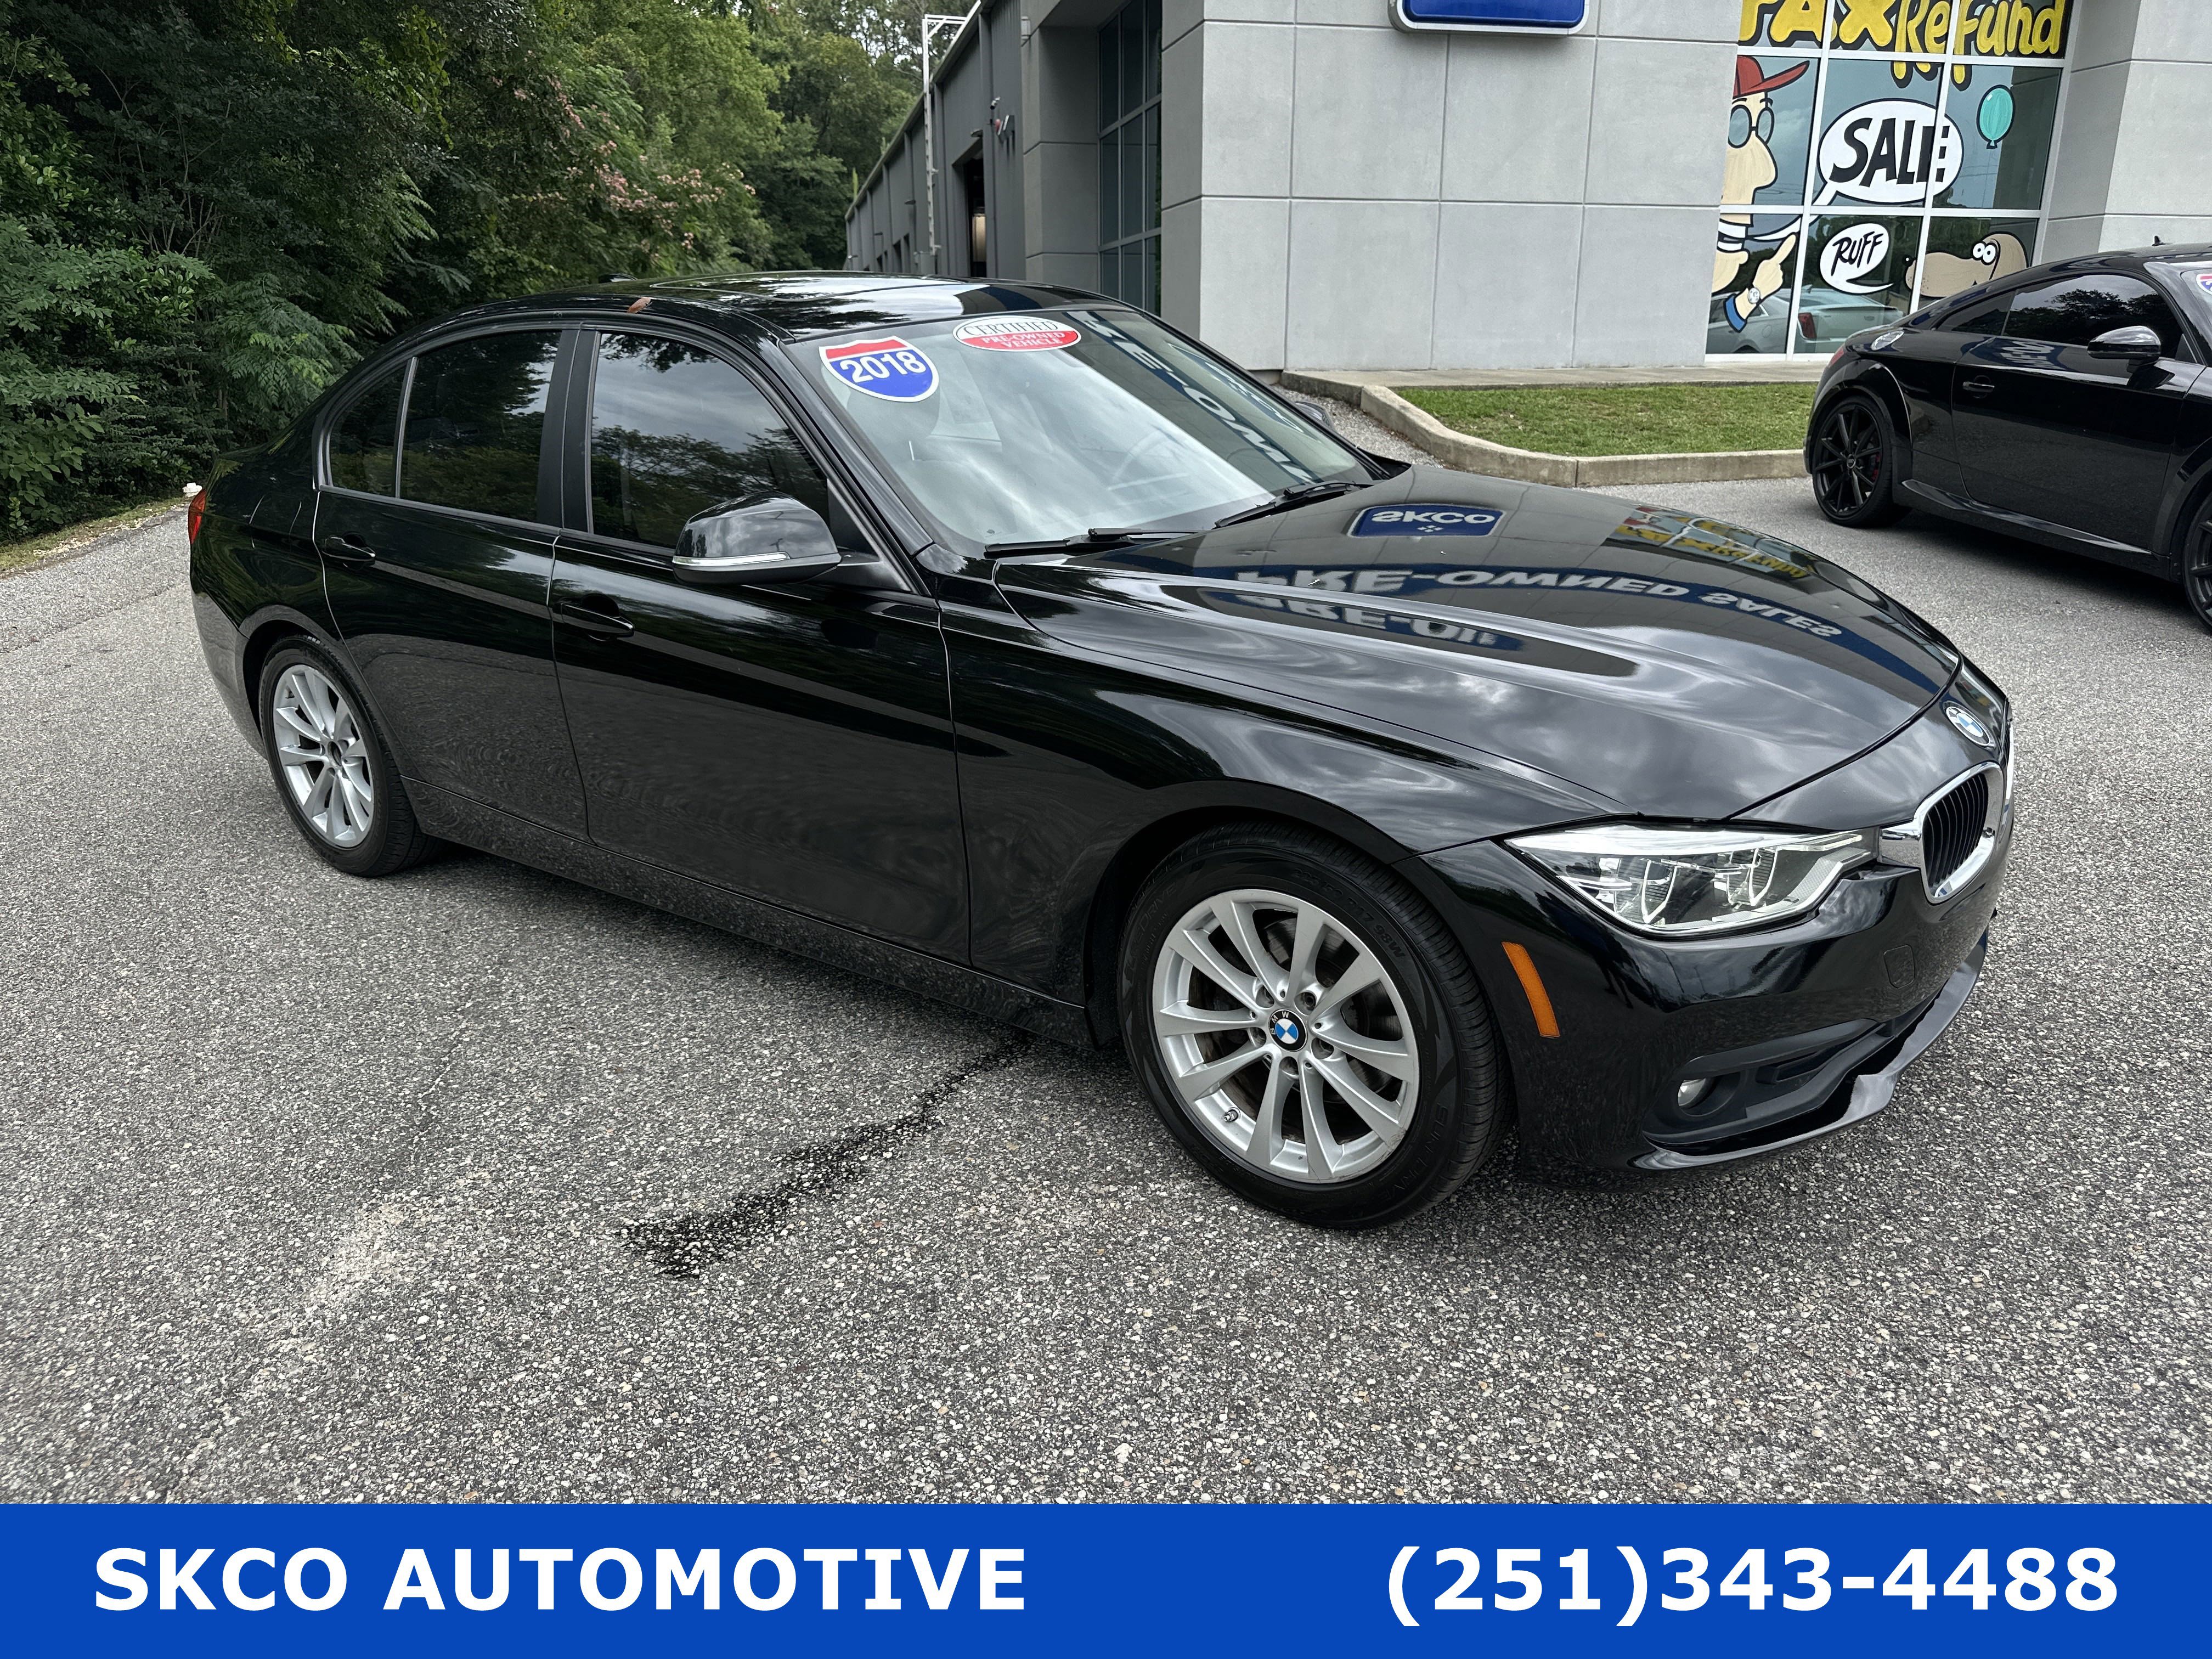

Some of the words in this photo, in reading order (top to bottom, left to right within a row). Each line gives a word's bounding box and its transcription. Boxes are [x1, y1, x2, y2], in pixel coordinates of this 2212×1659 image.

[1829, 117, 1950, 188] SALE
[1831, 230, 1883, 276] RUFF
[963, 320, 1058, 336] CERTIFIED
[981, 331, 1066, 344] PRE-OWNED
[1001, 337, 1064, 348] VEHICLE
[840, 351, 926, 383] 2018
[1270, 1011, 1290, 1035] BMW
